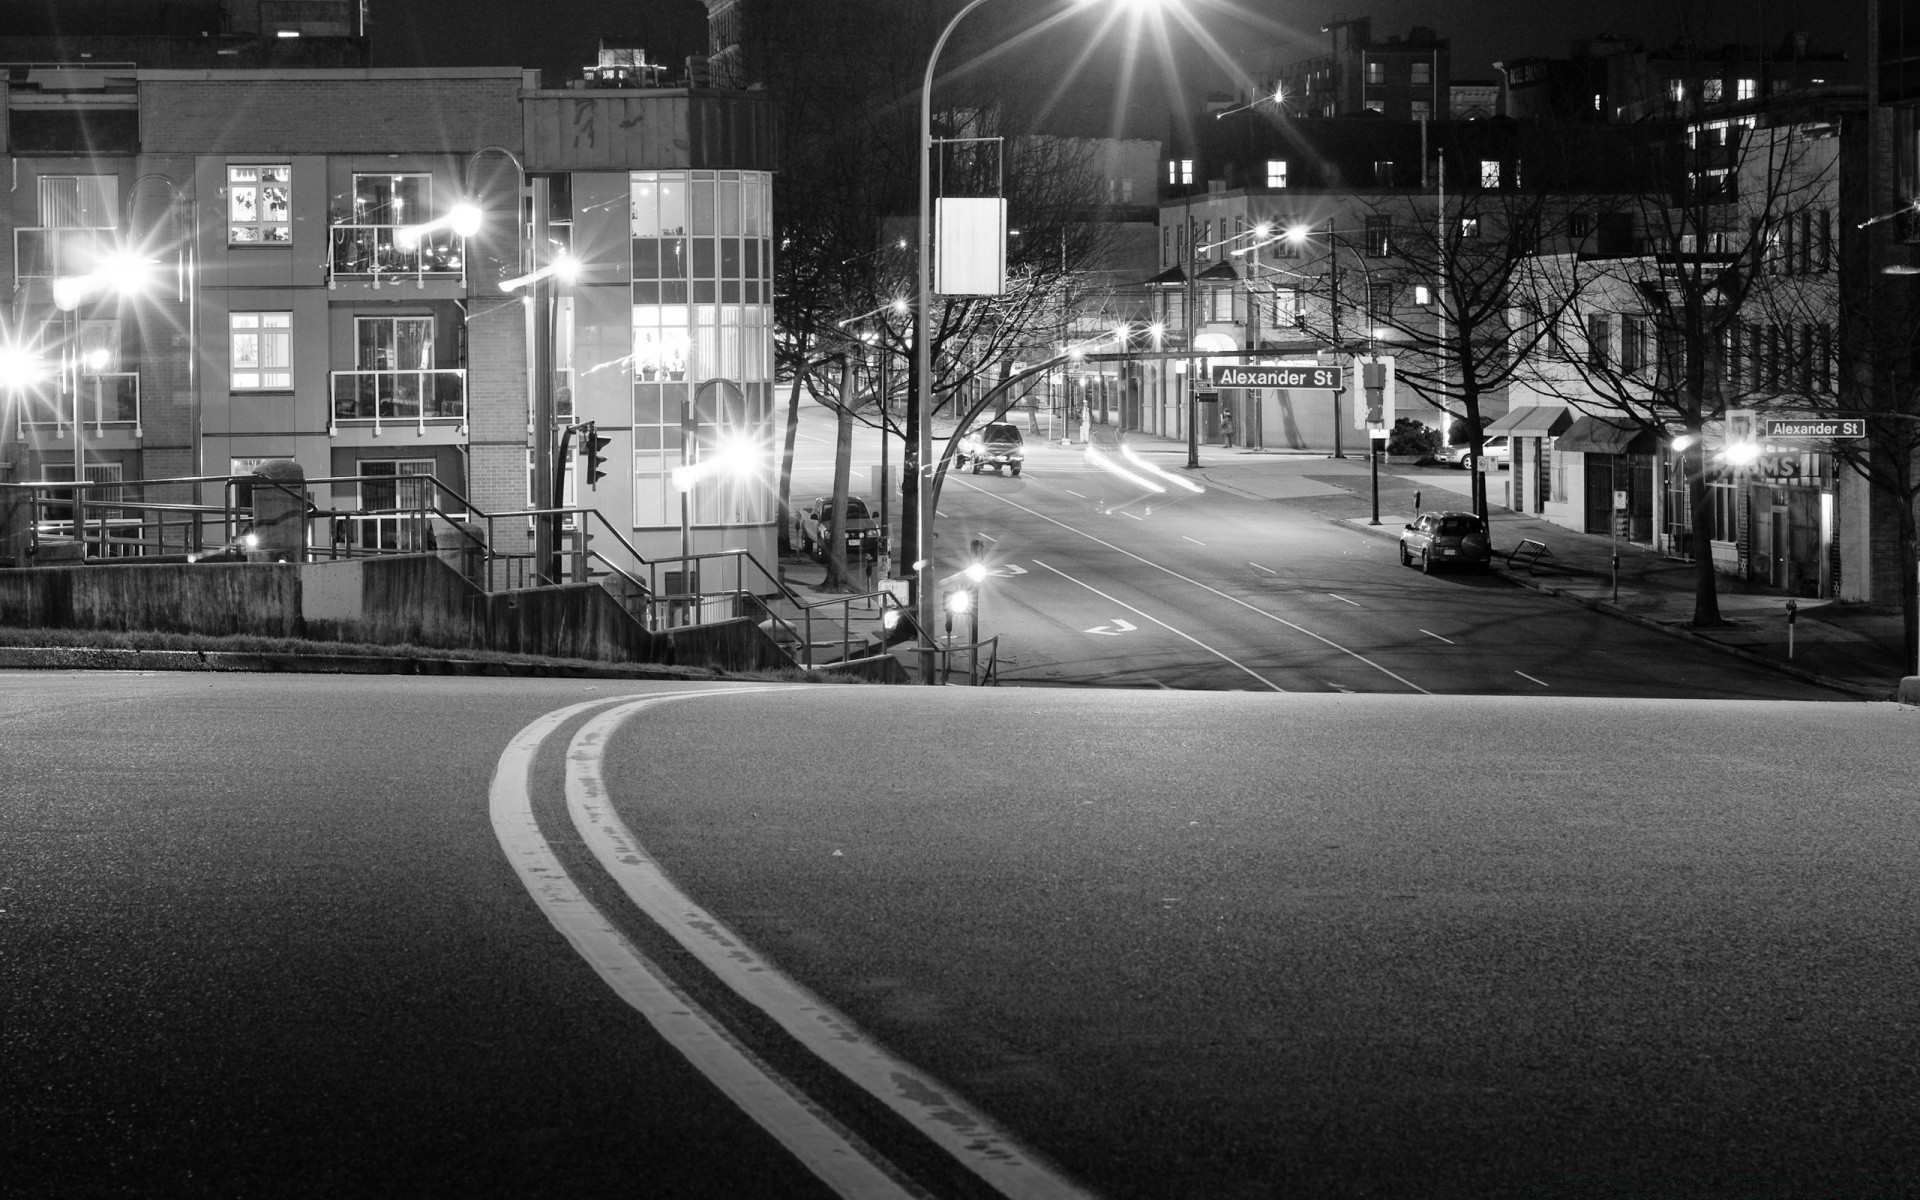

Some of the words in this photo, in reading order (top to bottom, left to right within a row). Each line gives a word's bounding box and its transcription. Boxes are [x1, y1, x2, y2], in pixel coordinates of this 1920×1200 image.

[1221, 369, 1306, 385] Alexander
[1314, 370, 1333, 386] St
[1773, 422, 1838, 435] Alexander
[1843, 422, 1858, 435] St
